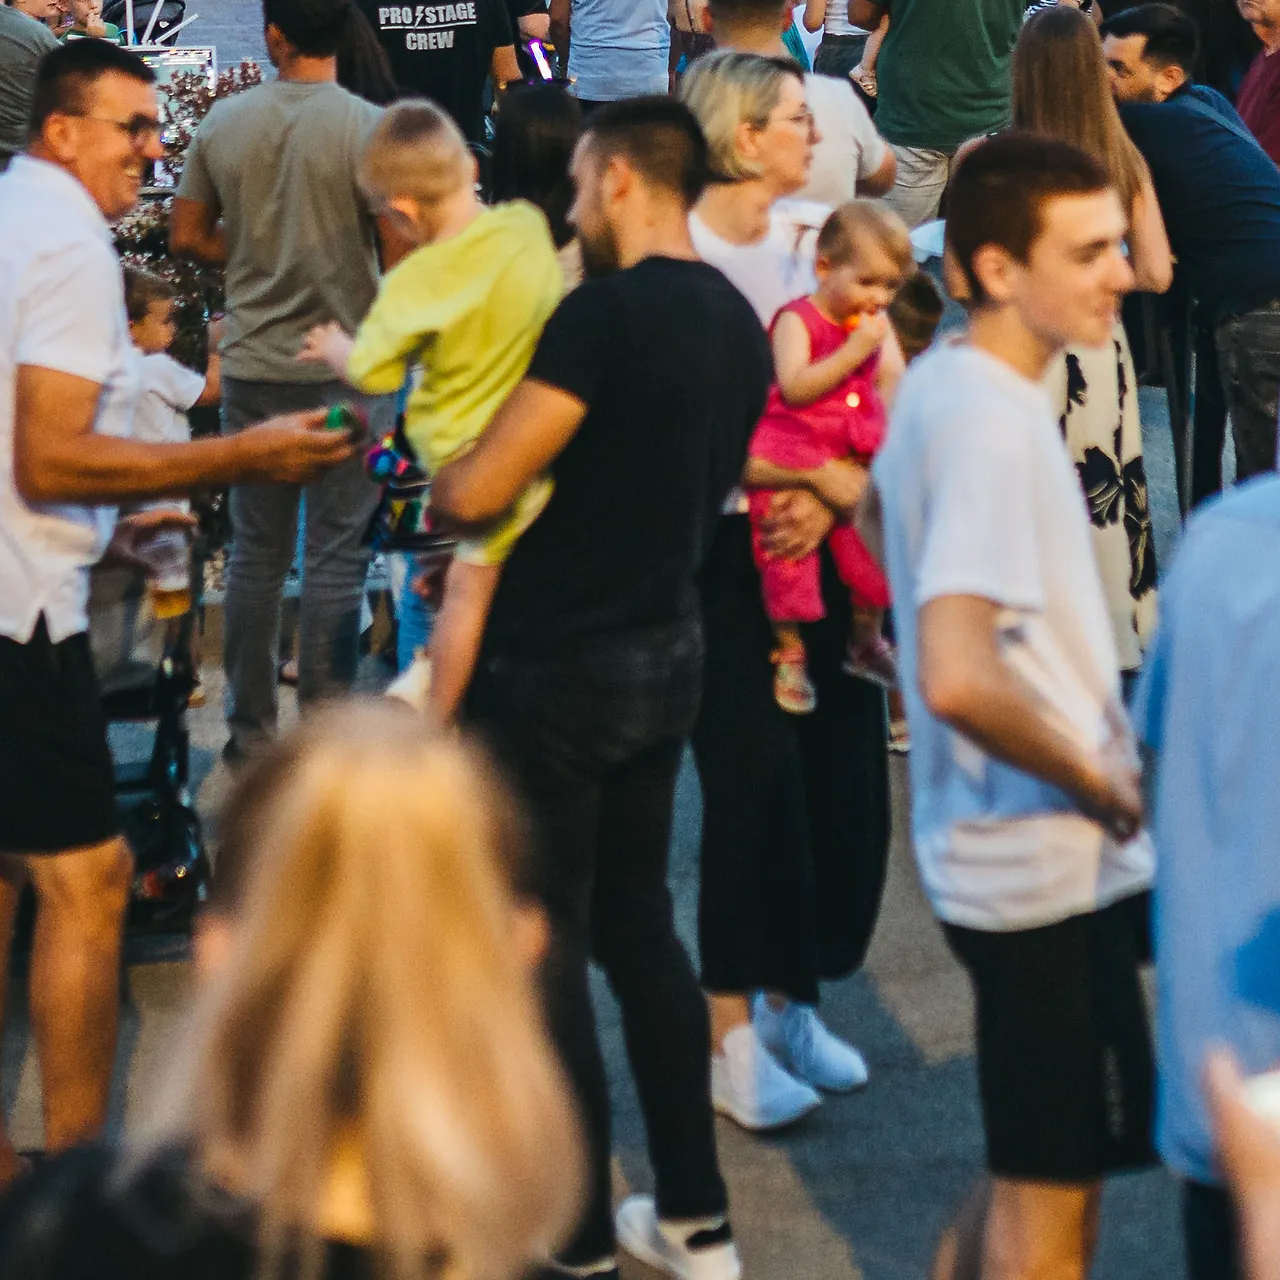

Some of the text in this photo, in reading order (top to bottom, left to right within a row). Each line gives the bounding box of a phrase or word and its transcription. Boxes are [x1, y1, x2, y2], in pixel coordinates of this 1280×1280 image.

[378, 2, 477, 24] PRO STAGE
[405, 31, 455, 50] CREW
